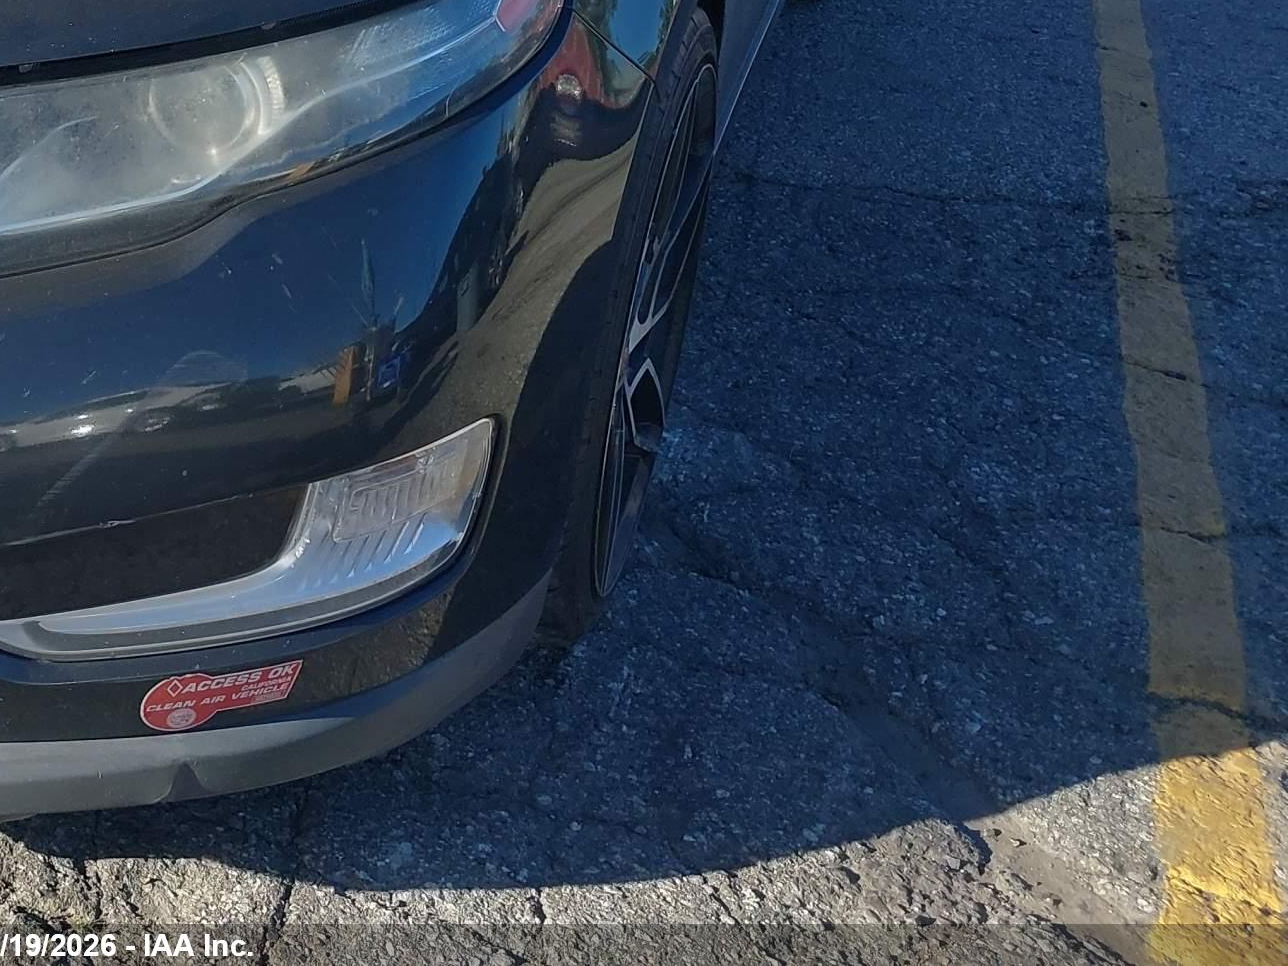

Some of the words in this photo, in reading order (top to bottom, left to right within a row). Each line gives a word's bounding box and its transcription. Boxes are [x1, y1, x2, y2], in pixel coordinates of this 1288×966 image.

[183, 672, 261, 694] ACCESS
[269, 664, 295, 679] OK
[241, 676, 292, 692] CALIFORNIA
[146, 699, 196, 712] CLEAN
[200, 695, 226, 706] AIR
[232, 683, 291, 701] VEHICLE
